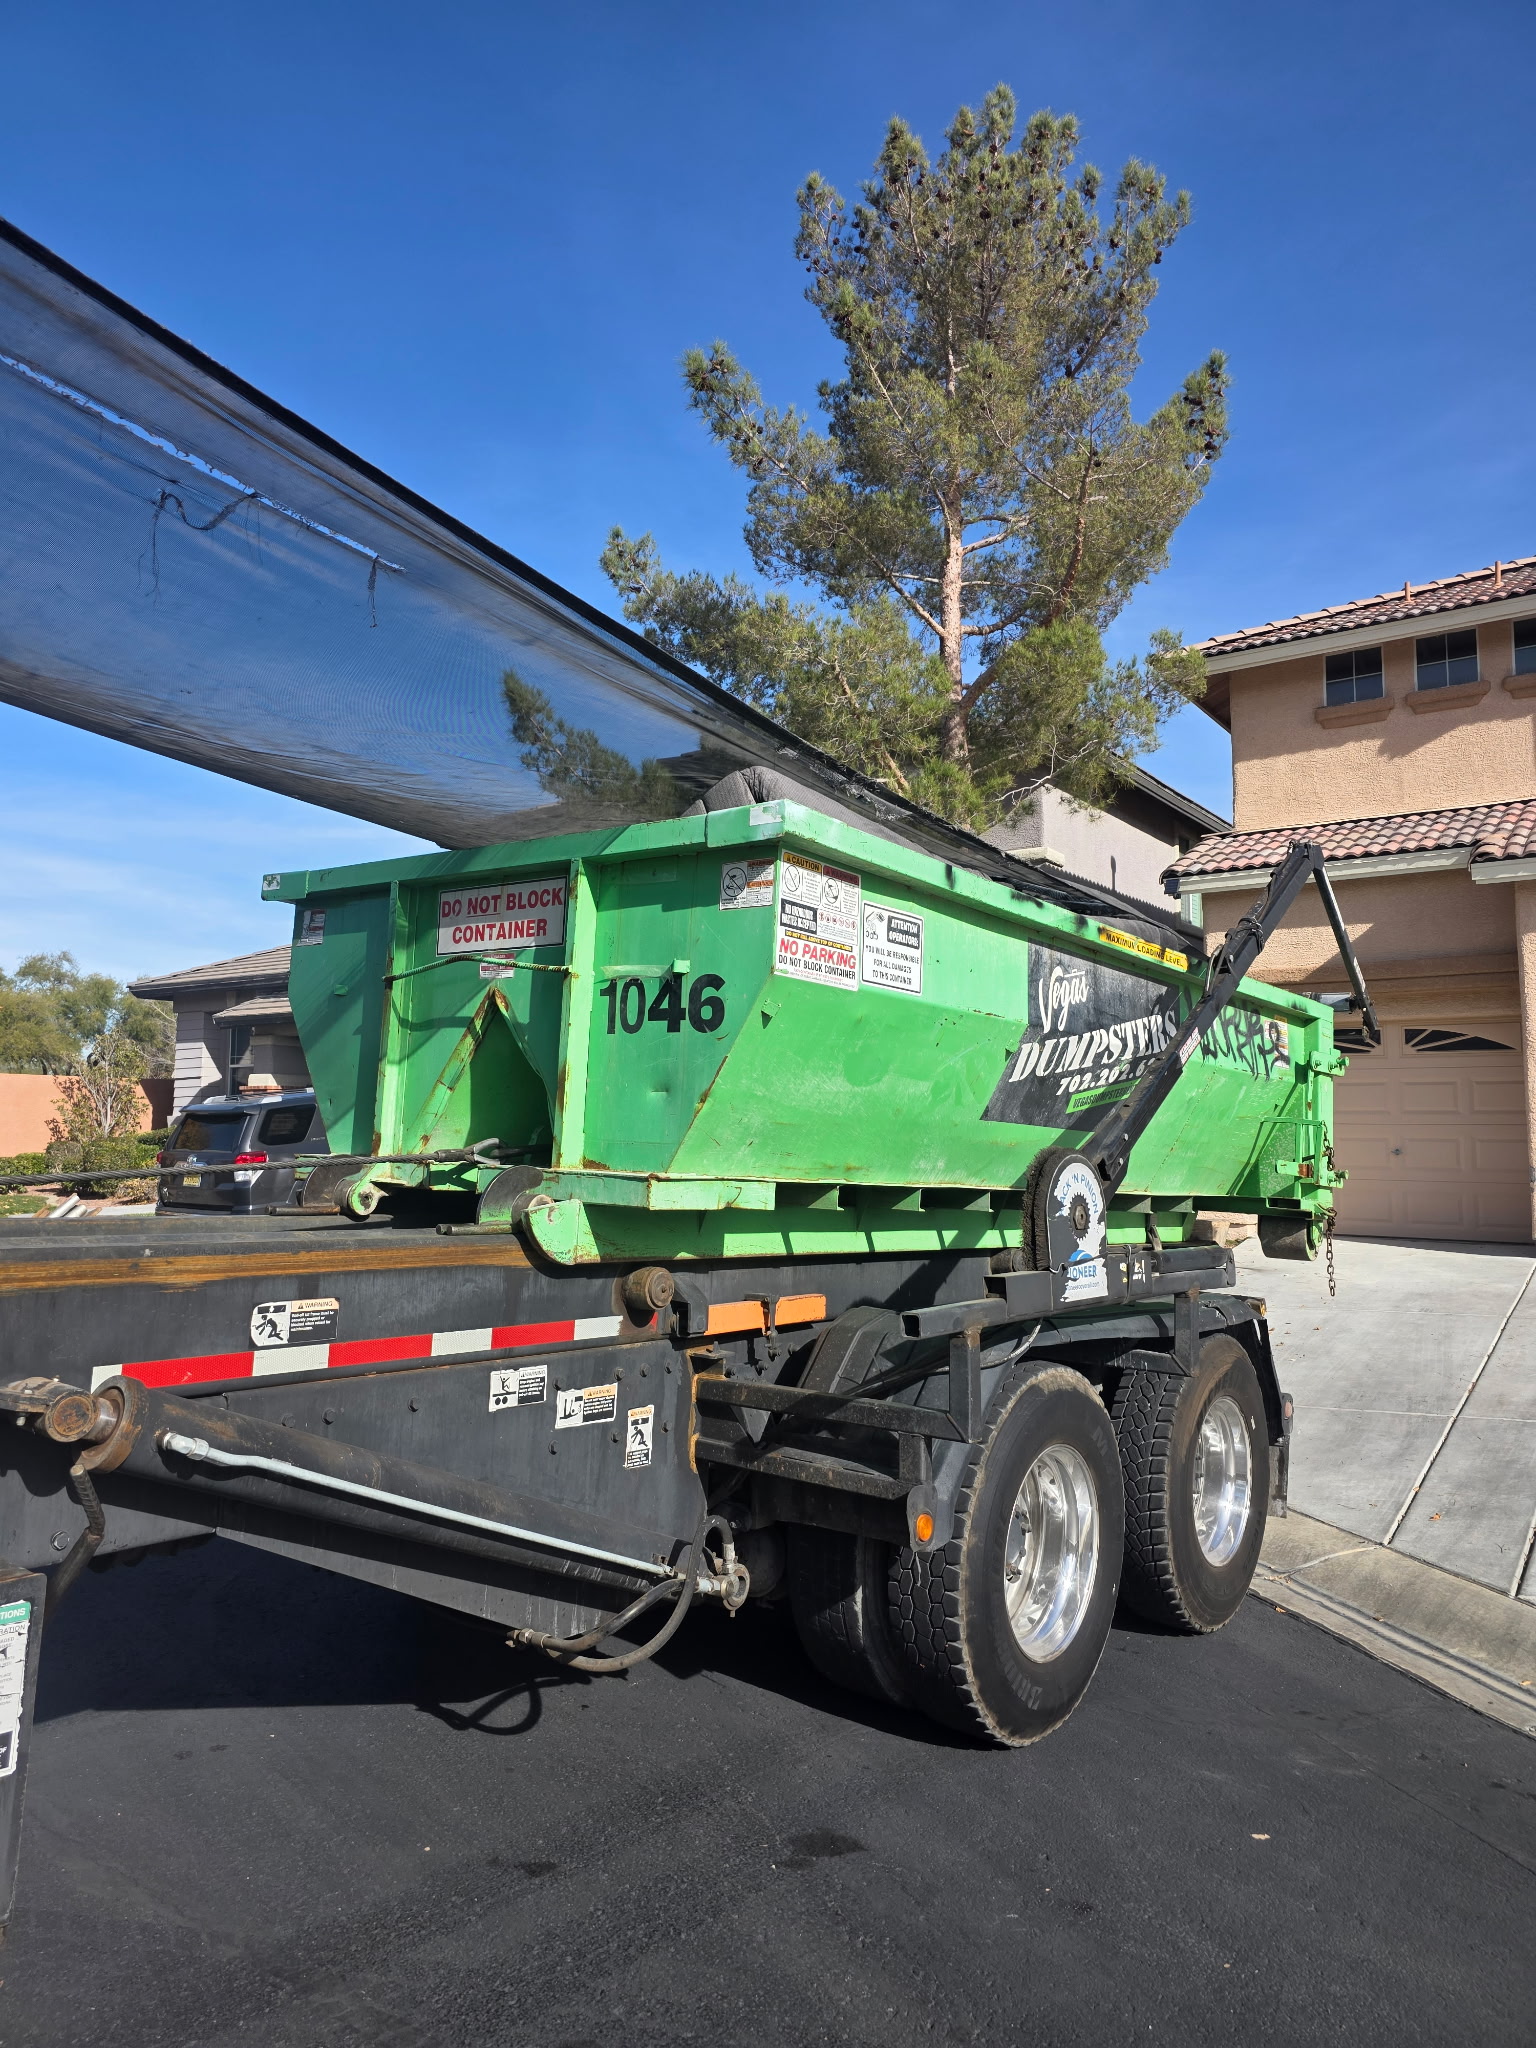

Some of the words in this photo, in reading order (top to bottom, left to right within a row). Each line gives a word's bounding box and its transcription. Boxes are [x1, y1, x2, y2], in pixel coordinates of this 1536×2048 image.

[791, 856, 820, 871] CAUTION
[441, 899, 462, 918] DO
[466, 894, 502, 915] NOT
[506, 887, 564, 911] BLOCK
[452, 918, 548, 944] CONTAINER
[891, 918, 918, 934] ATTENTION
[779, 938, 799, 956] NO
[802, 943, 857, 969] PARKING
[873, 959, 883, 967] FOR
[1137, 945, 1165, 960] LOADING
[778, 955, 788, 965] DO
[789, 957, 802, 968] NOT
[803, 960, 823, 972] BLOCK
[825, 964, 856, 980] CONTAINER
[599, 973, 726, 1035] 1046
[1039, 965, 1090, 1034] Vegas
[1009, 1009, 1178, 1083] DUMPSTERS
[1055, 1057, 1156, 1096] 702.202.6
[1081, 1173, 1099, 1215] PINION
[1068, 1264, 1098, 1279] IONEER
